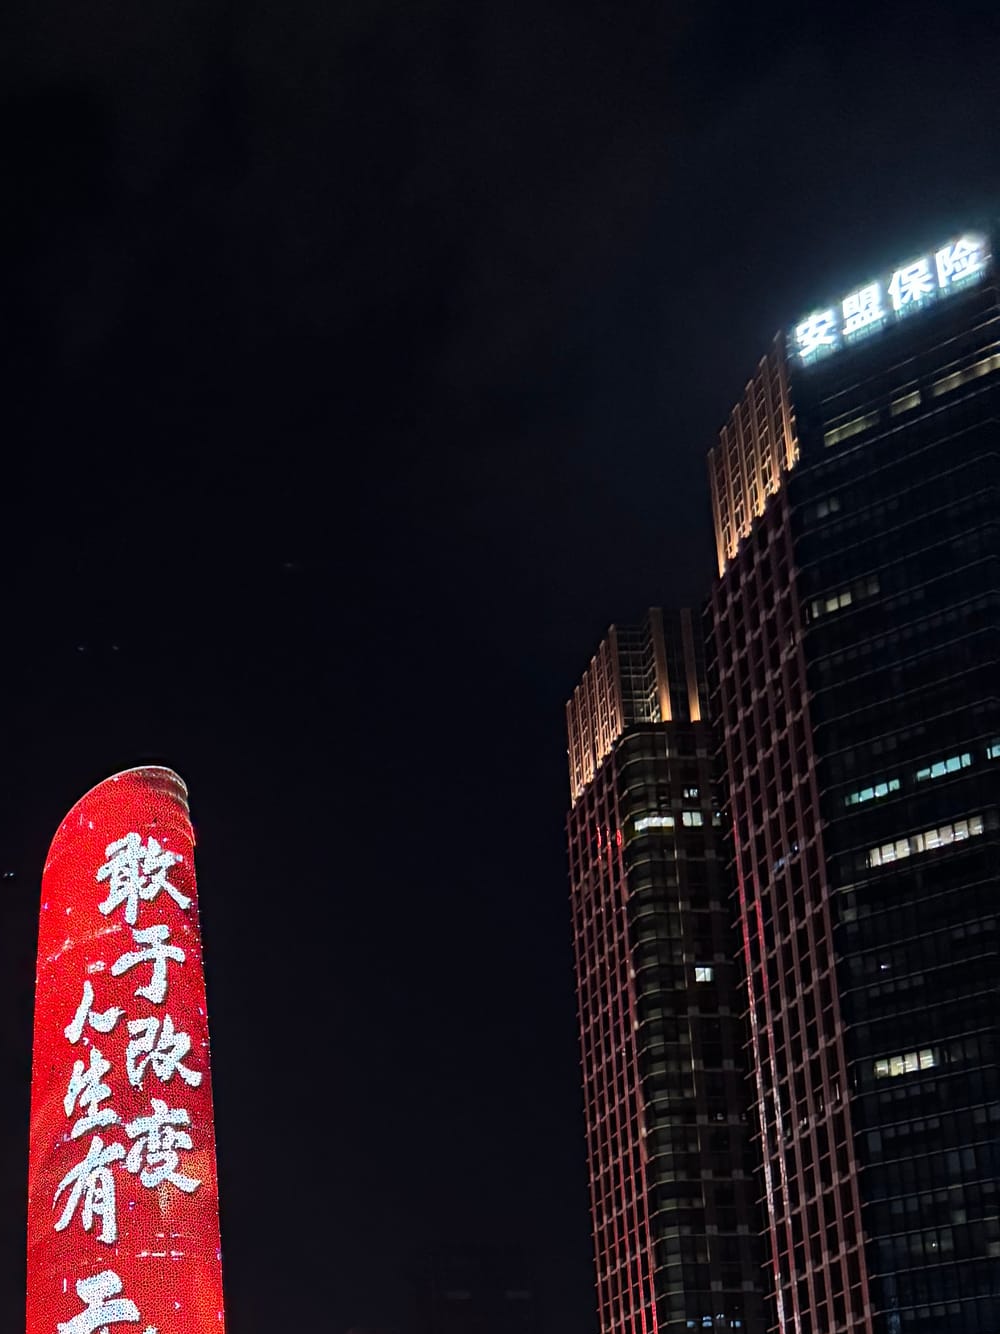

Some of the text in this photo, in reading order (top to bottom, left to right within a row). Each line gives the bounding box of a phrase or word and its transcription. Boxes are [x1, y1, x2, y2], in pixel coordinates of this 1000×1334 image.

[795, 237, 985, 359] 安盟保险
[96, 832, 204, 1194] 敢于改变
